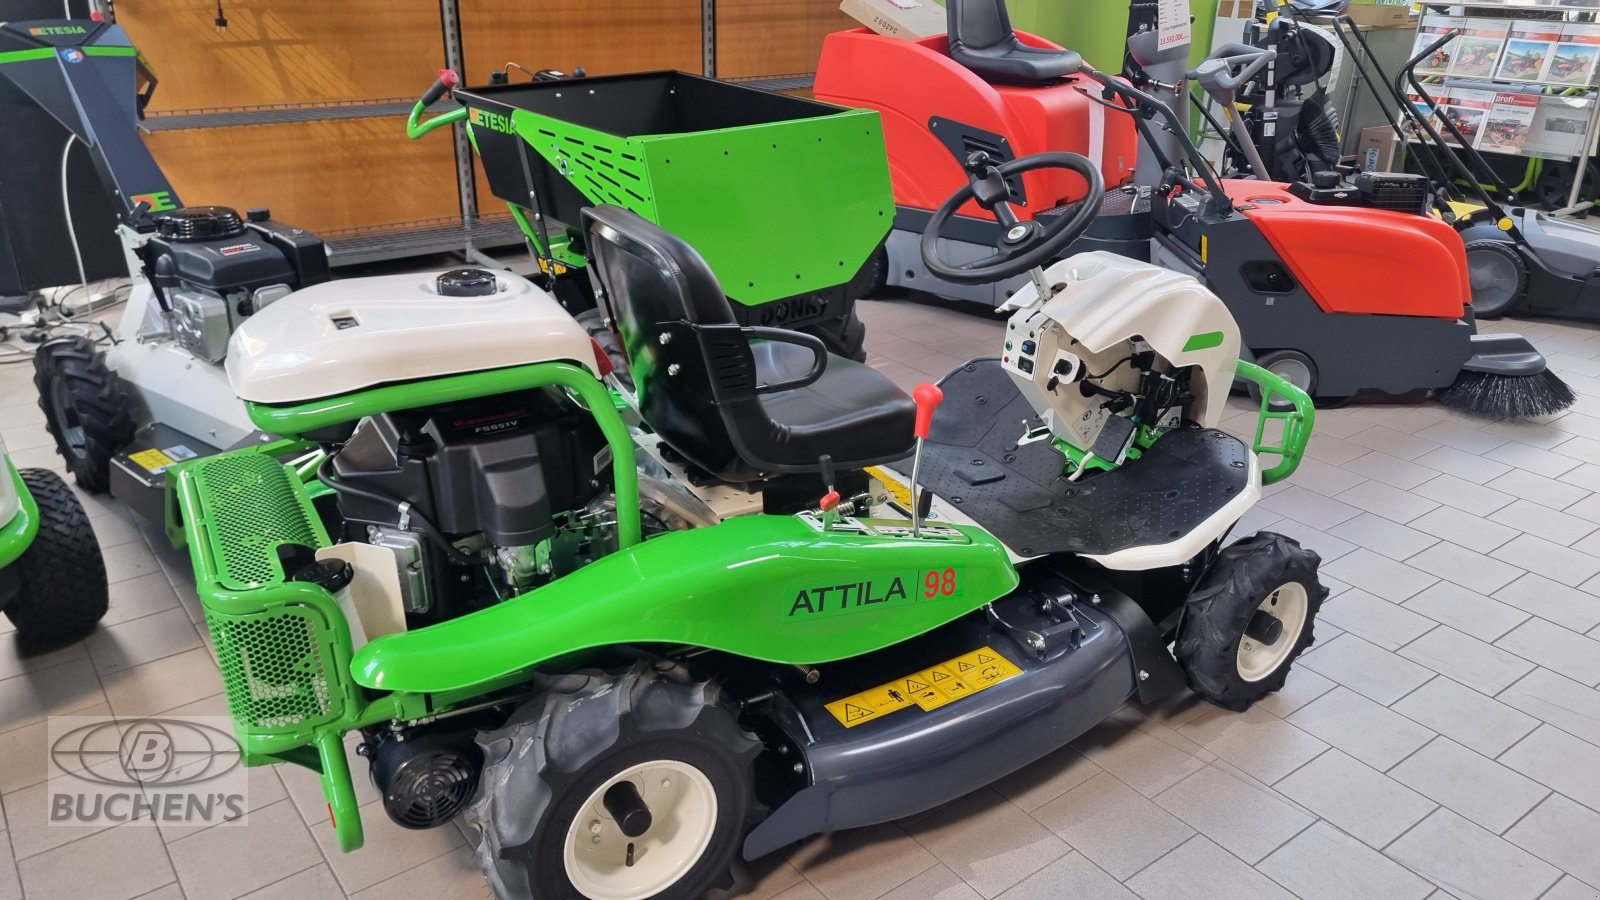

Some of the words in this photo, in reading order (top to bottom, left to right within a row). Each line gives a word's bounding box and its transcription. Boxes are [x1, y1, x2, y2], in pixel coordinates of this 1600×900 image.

[29, 26, 87, 36] ETESIA
[1495, 95, 1514, 103] profi
[470, 107, 516, 135] ETESIA
[761, 298, 828, 326] DONKY
[788, 577, 907, 617] ATTILA
[924, 567, 957, 599] 98
